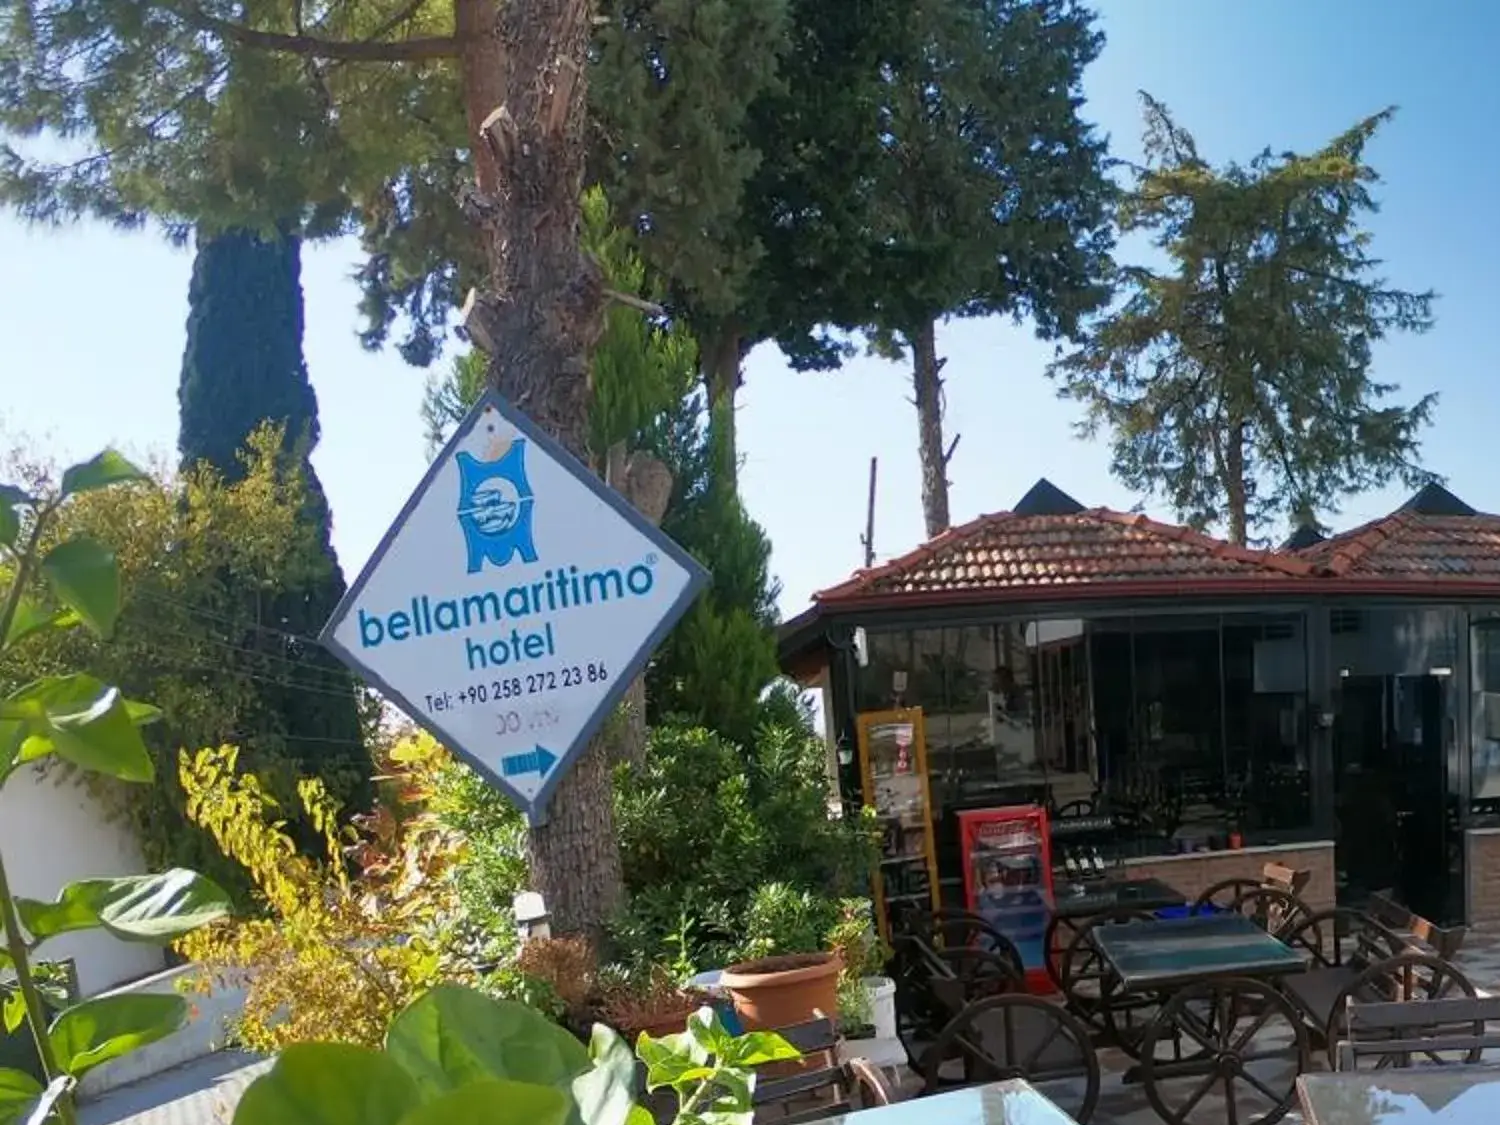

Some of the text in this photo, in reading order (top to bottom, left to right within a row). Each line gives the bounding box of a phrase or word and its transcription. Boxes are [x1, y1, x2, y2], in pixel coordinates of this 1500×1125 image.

[358, 564, 653, 648] bellamaritimo
[465, 624, 556, 670] hotel
[424, 661, 608, 713] Tel: +90 258 272 23 86
